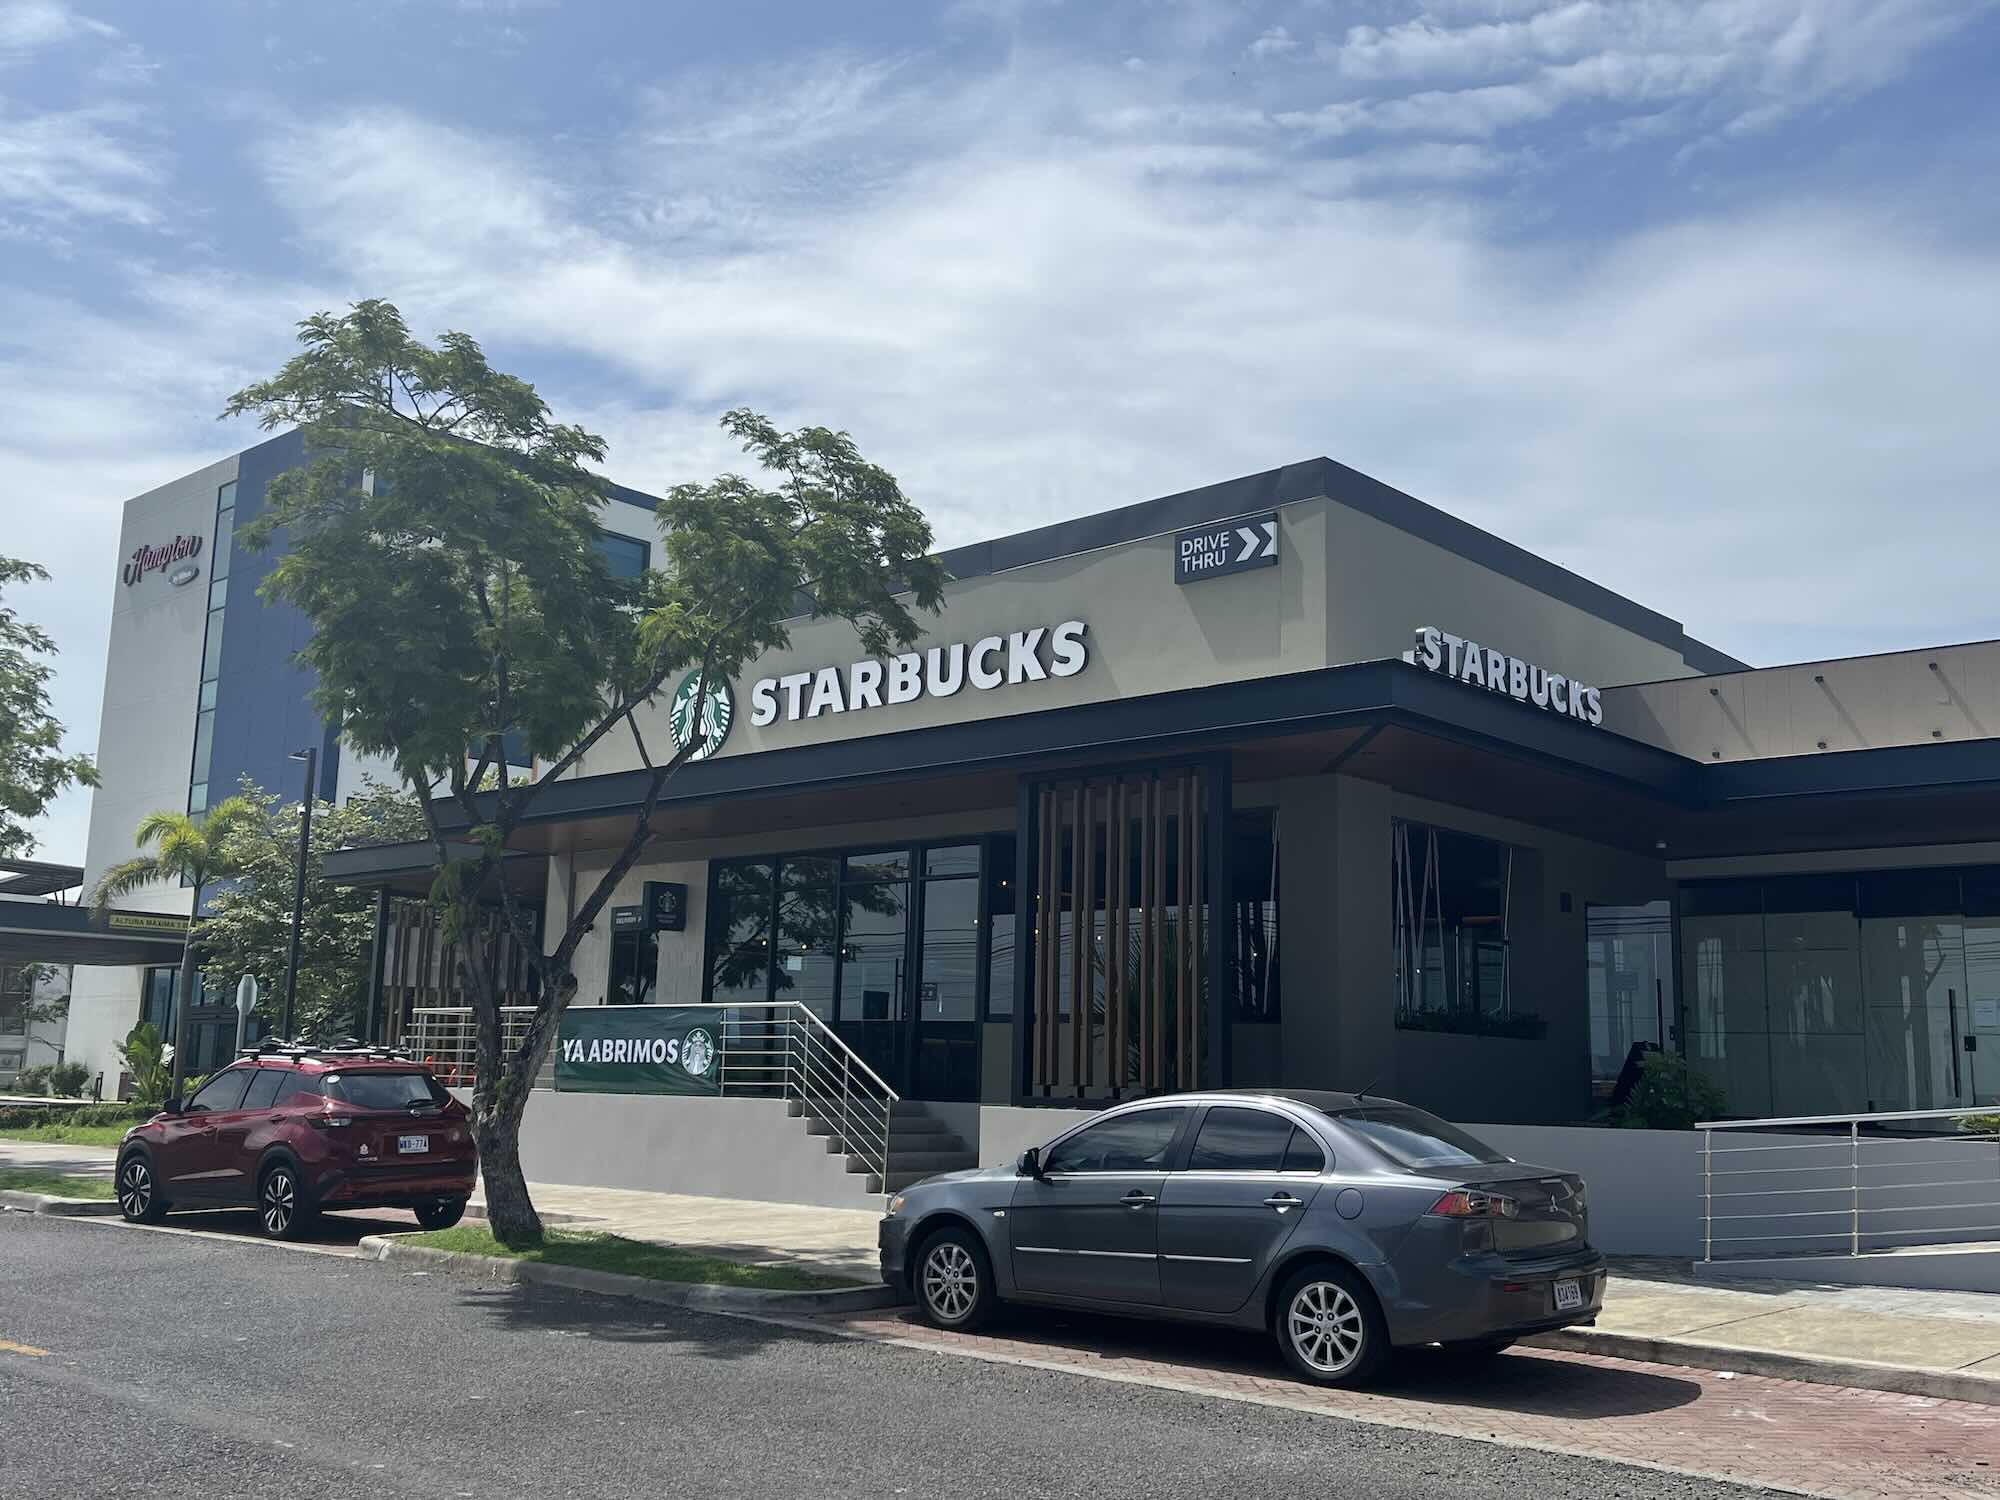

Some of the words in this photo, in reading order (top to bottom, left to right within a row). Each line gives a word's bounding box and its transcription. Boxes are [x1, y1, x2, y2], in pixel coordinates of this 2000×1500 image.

[124, 535, 203, 586] Hampton
[1181, 531, 1230, 556] DRIVE
[1181, 549, 1226, 573] THRU
[751, 621, 1087, 727] STARBUCKS
[1418, 626, 1603, 725] STARBUCKS
[562, 1039, 585, 1063] YA
[587, 1038, 680, 1064] ABRIMOS
